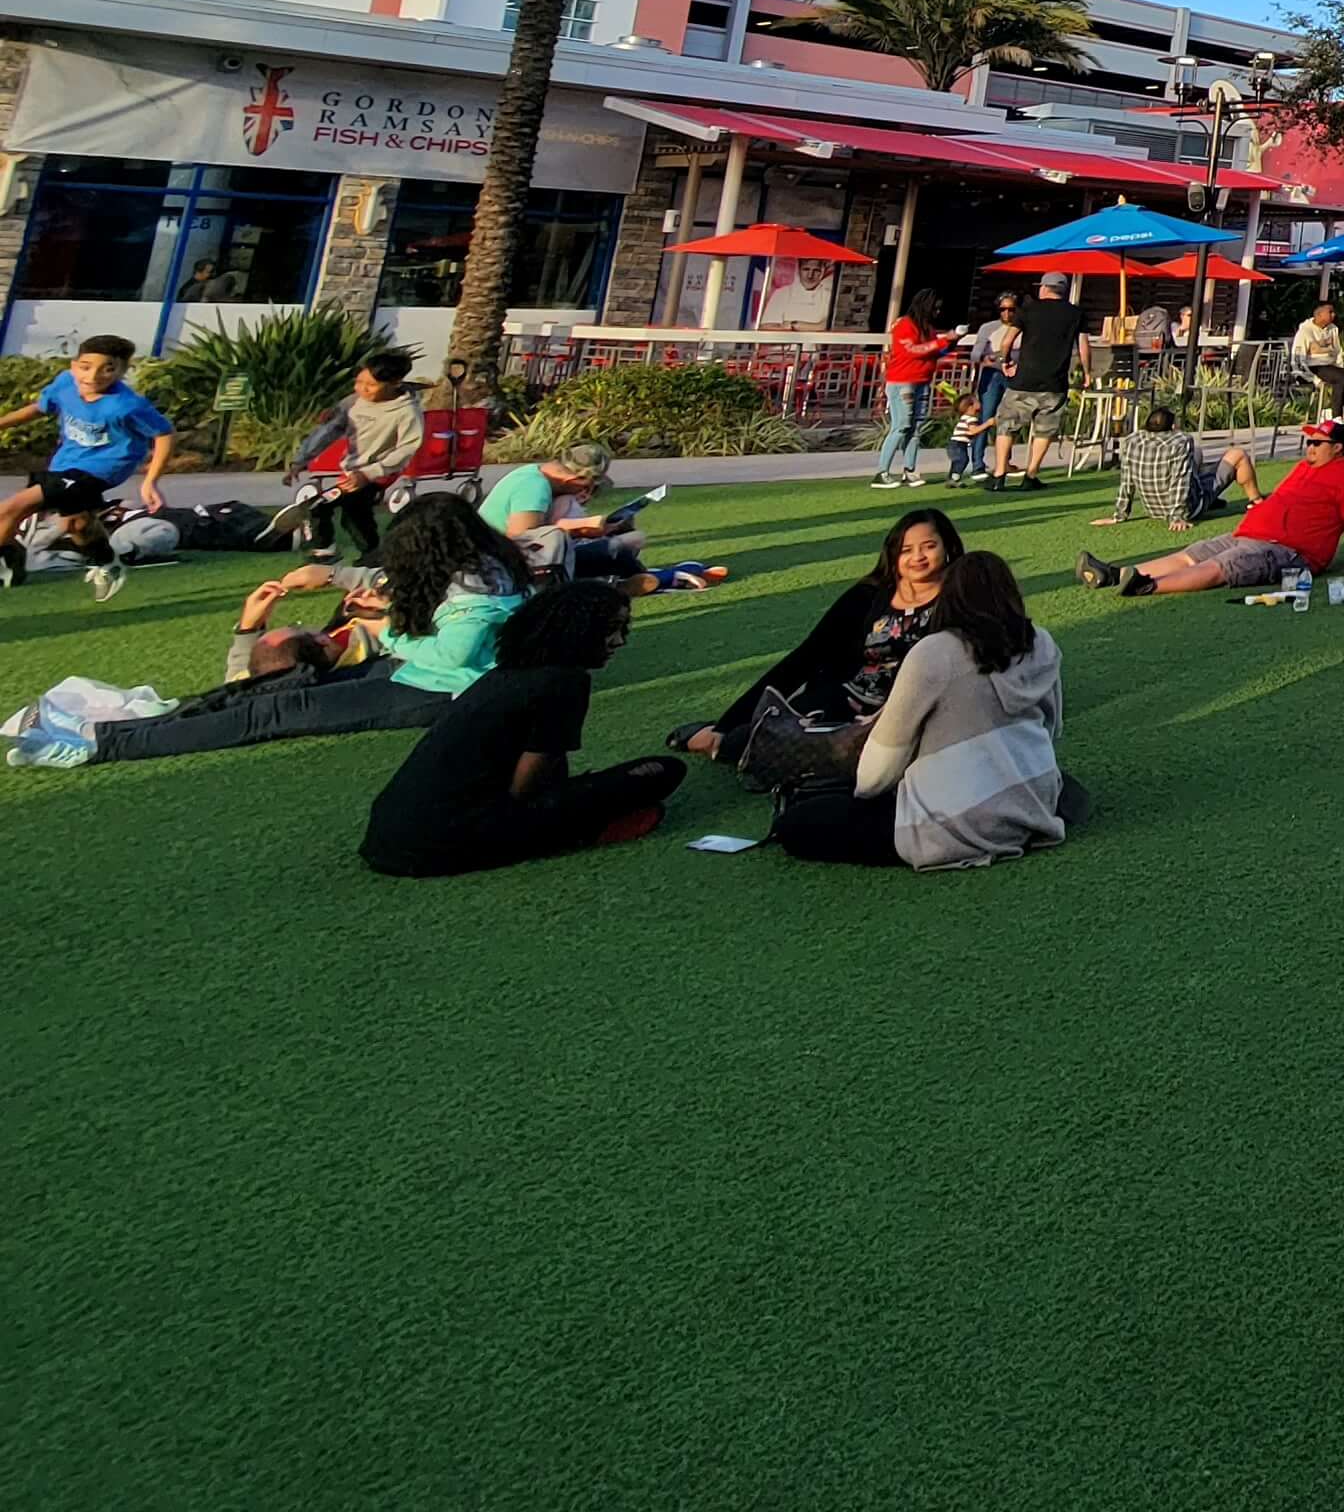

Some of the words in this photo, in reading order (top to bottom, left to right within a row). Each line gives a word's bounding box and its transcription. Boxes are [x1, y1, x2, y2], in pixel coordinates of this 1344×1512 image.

[322, 91, 494, 122] GORDON
[319, 109, 491, 138] RAMSAY
[313, 126, 379, 146] FISH
[385, 133, 403, 149] &
[409, 135, 489, 156] CHIPS
